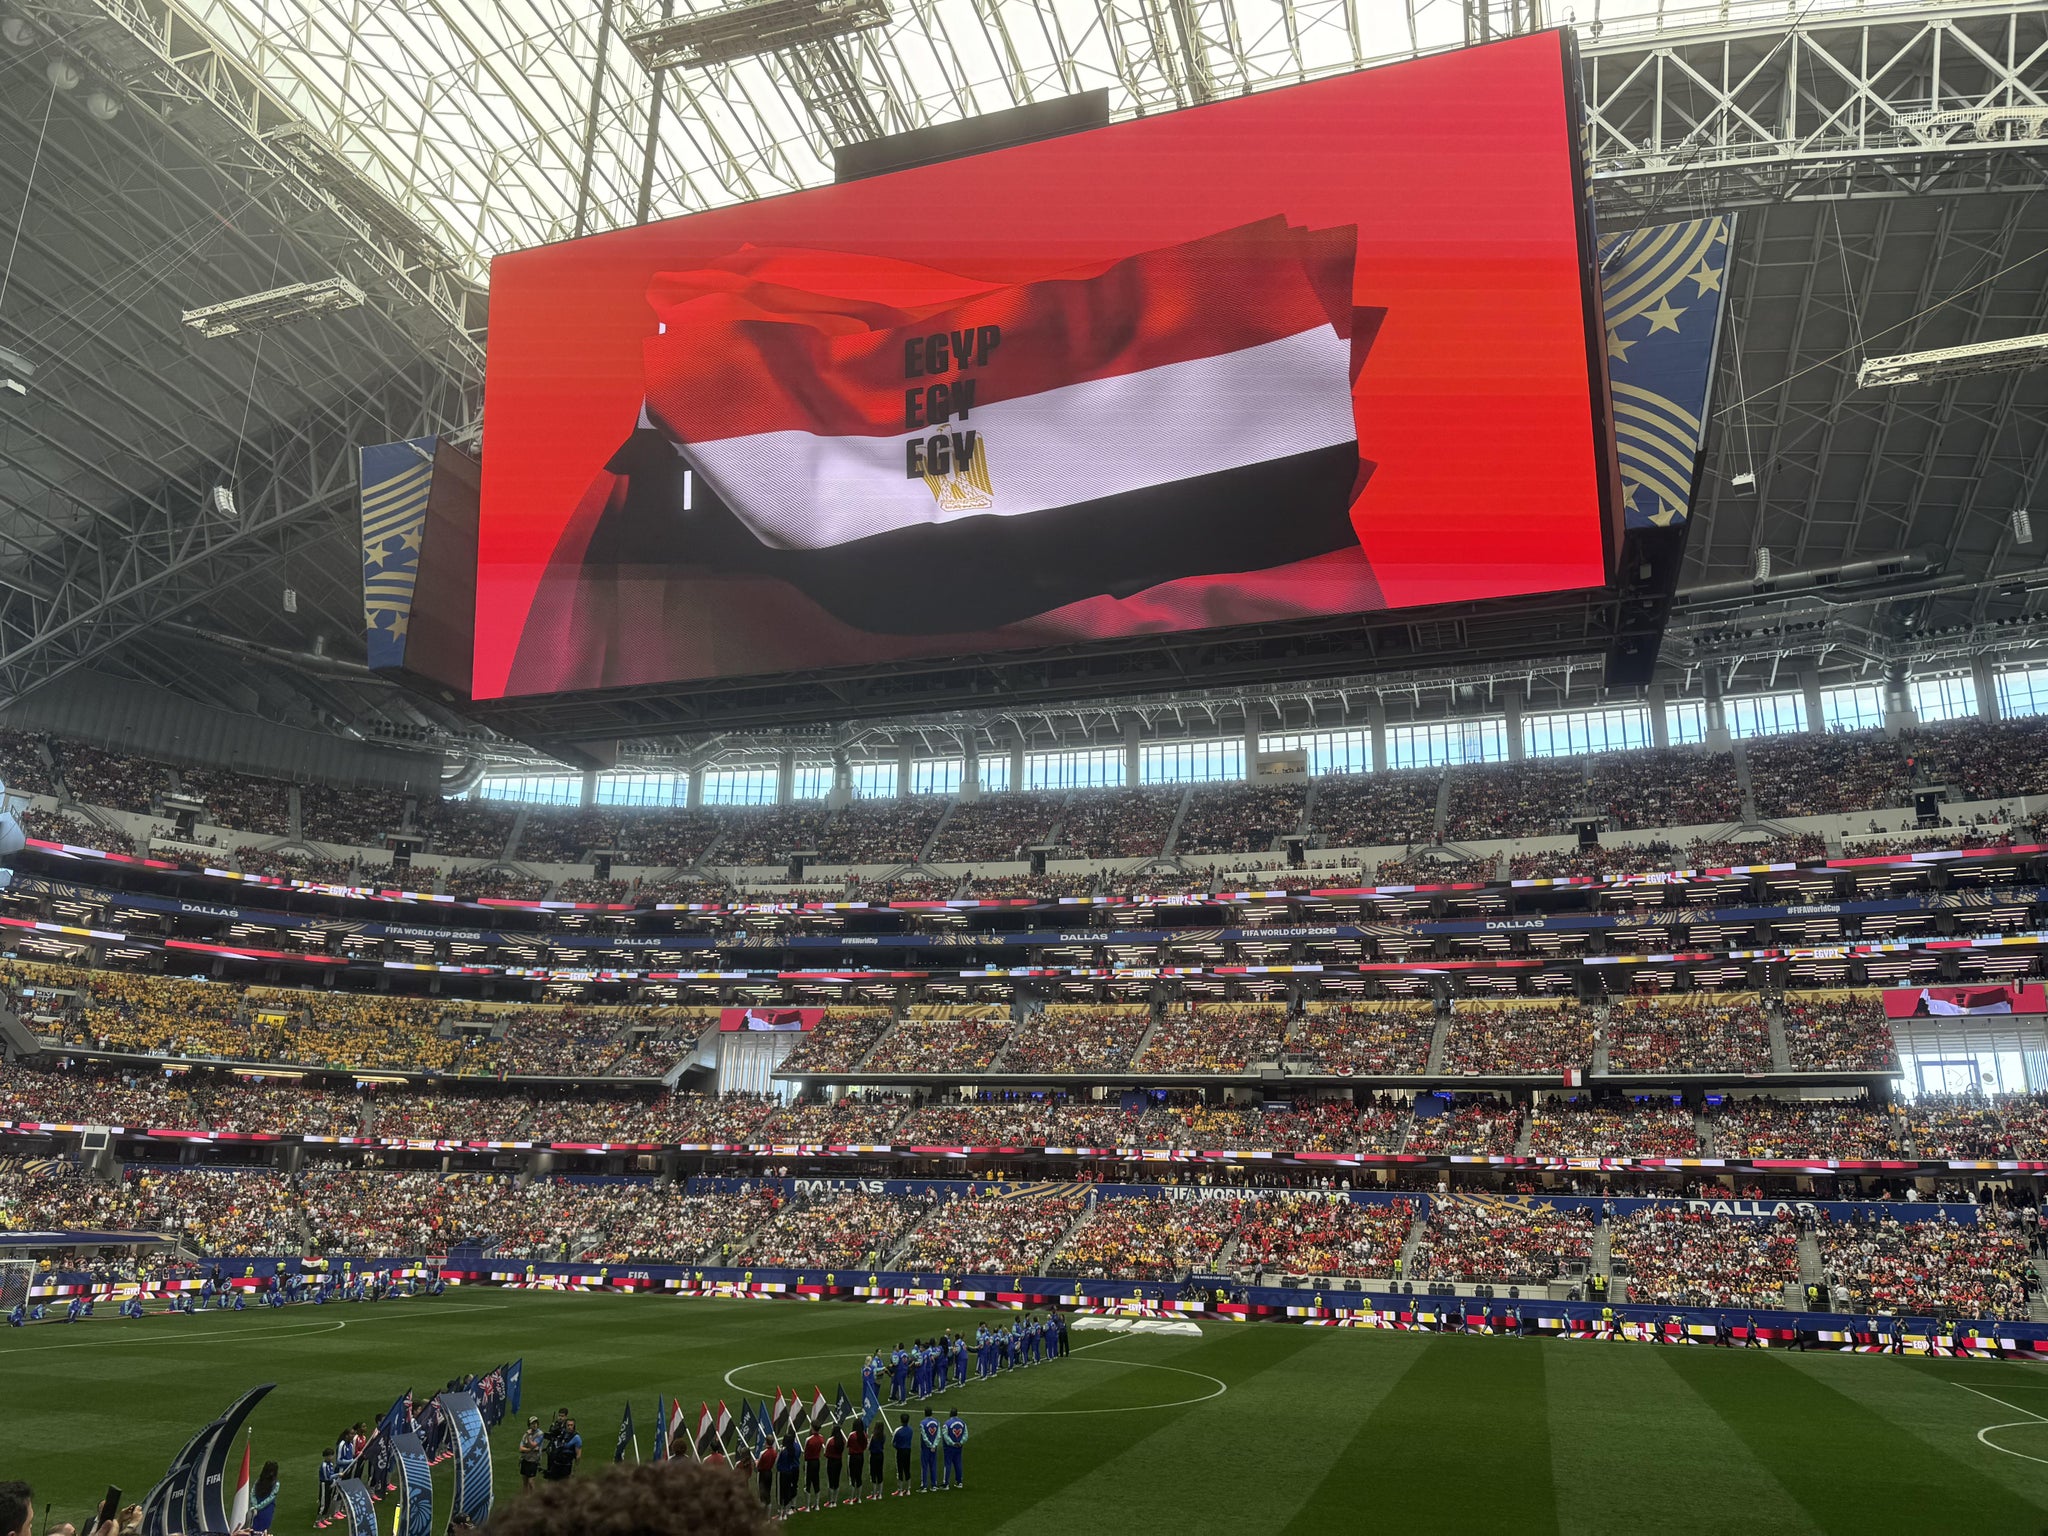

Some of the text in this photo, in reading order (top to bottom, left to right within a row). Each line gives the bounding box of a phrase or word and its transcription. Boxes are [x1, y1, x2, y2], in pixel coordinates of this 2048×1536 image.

[905, 325, 1001, 378] EGYP
[906, 430, 977, 479] EGY
[1646, 872, 1672, 884] EGYPT
[181, 903, 239, 918] DALLAS
[1787, 904, 1841, 915] #FIFAWorldCup
[1485, 920, 1545, 930] DALLAS
[385, 926, 403, 935] FIFA
[404, 928, 434, 937] WORLD
[452, 932, 481, 940] 2026
[1060, 933, 1109, 942] DALLAS
[1242, 927, 1338, 937] FIFA WORLD CUP 2026
[613, 938, 662, 946] DALLAS
[1814, 948, 1839, 959] EGYPT
[628, 1271, 650, 1279] FIFA
[1070, 1316, 1202, 1336] FIFA
[206, 1473, 222, 1486] FIFA
[171, 1489, 184, 1500] FIFA
